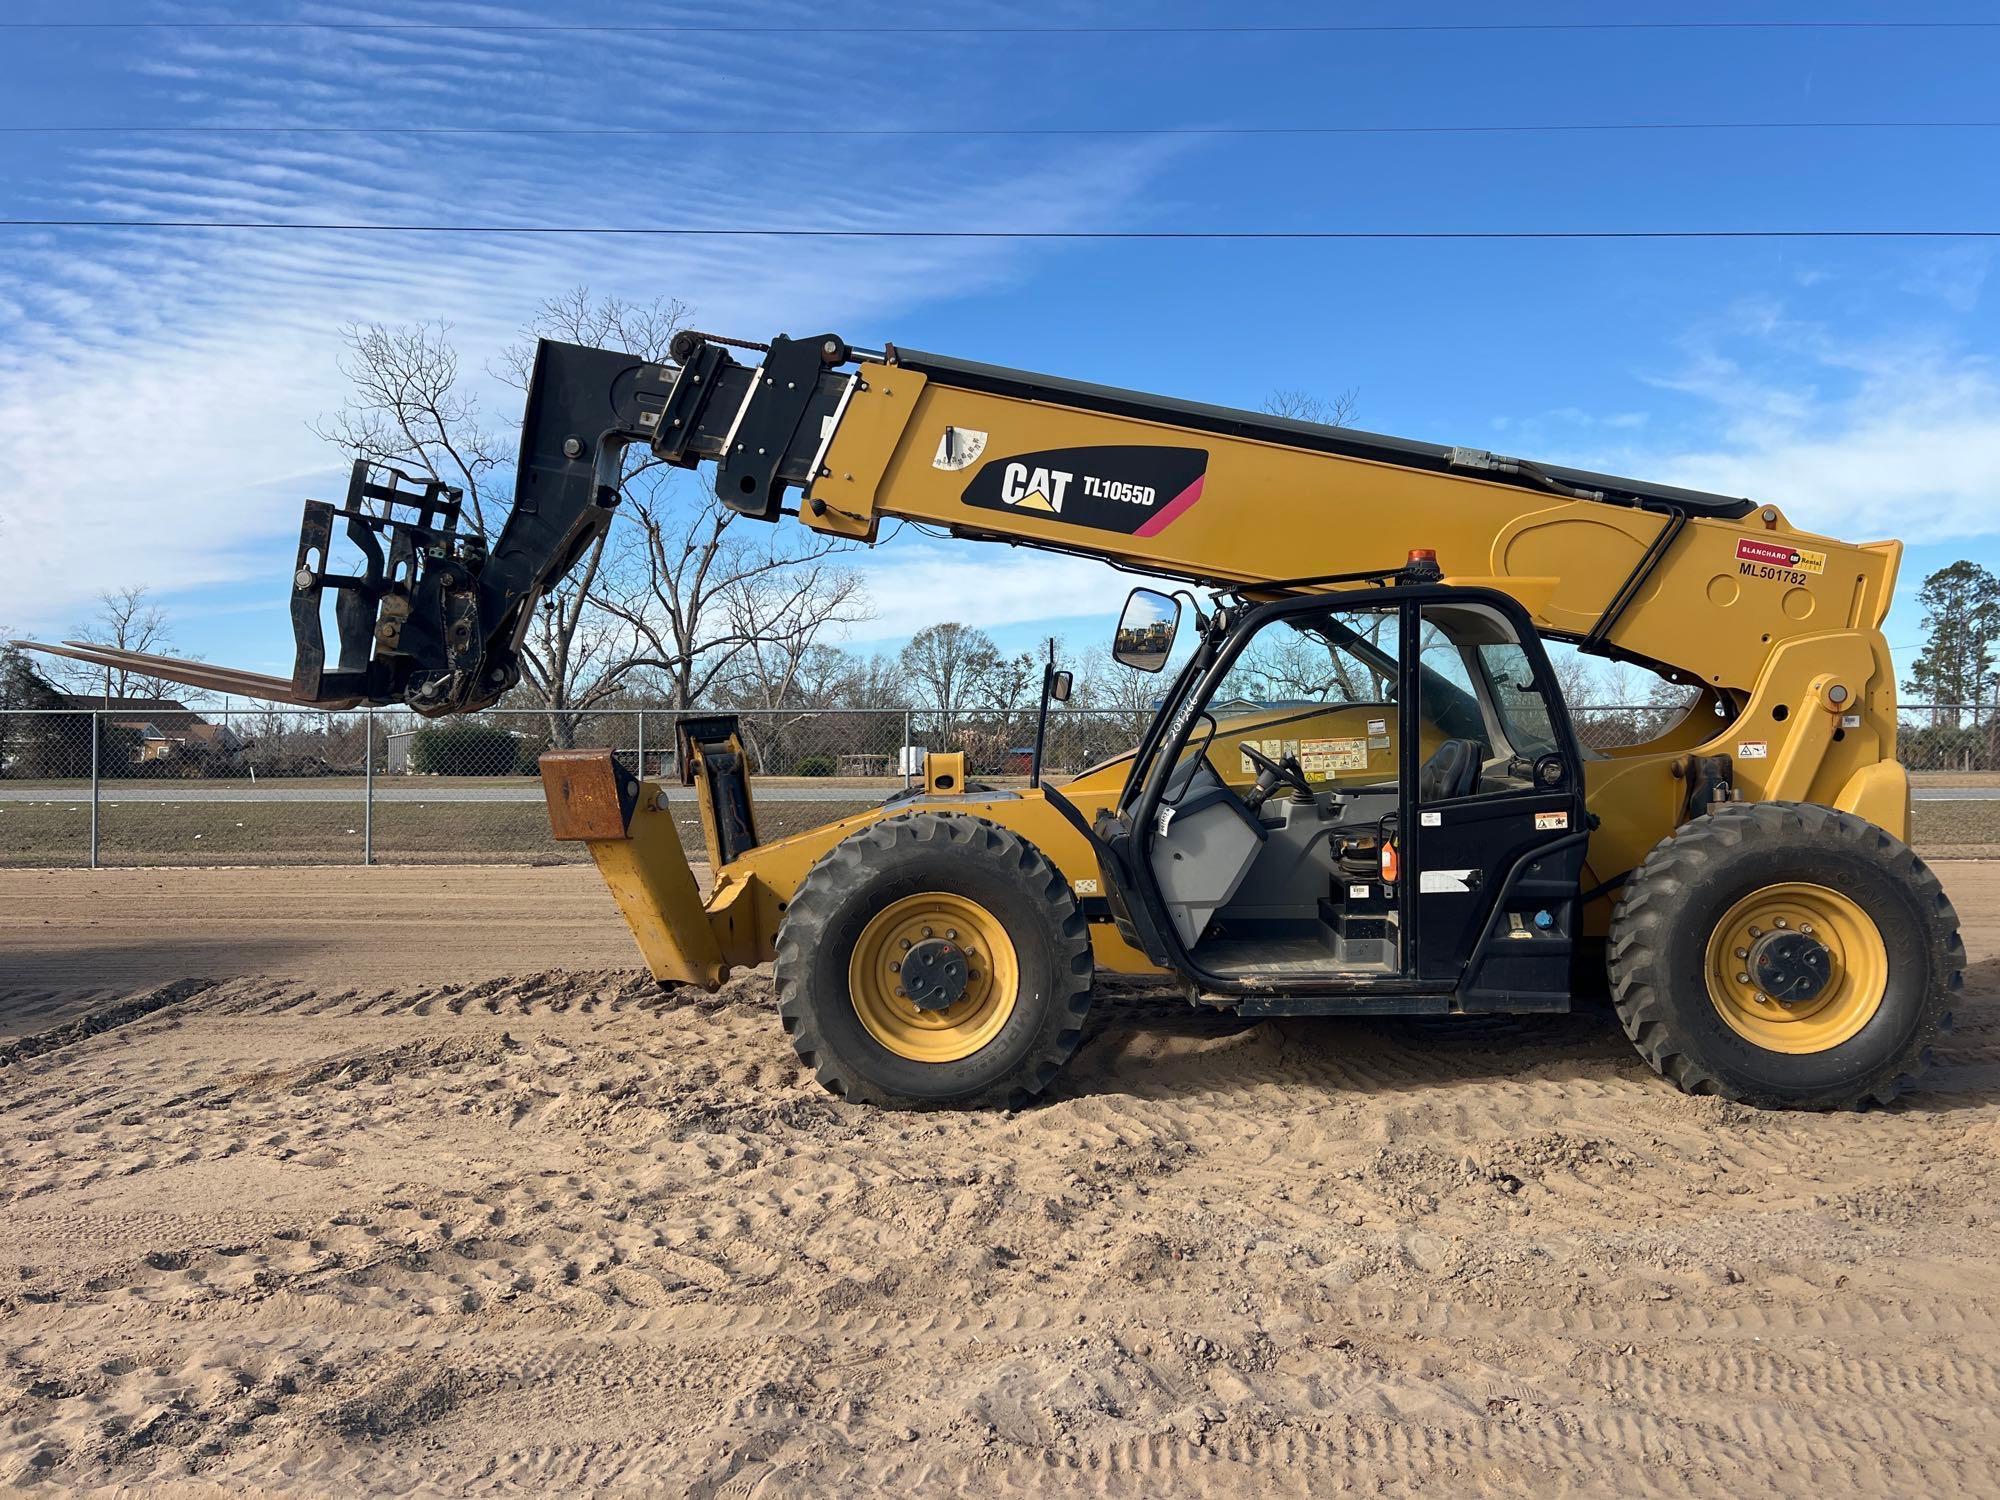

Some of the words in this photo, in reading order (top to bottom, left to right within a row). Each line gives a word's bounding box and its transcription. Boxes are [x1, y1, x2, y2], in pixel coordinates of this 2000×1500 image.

[1001, 462, 1073, 513] CAT
[1083, 475, 1156, 506] TL1055D
[1742, 546, 1787, 560] BLANCHARD
[1801, 557, 1822, 566] Rental
[1739, 562, 1807, 586] ML501782
